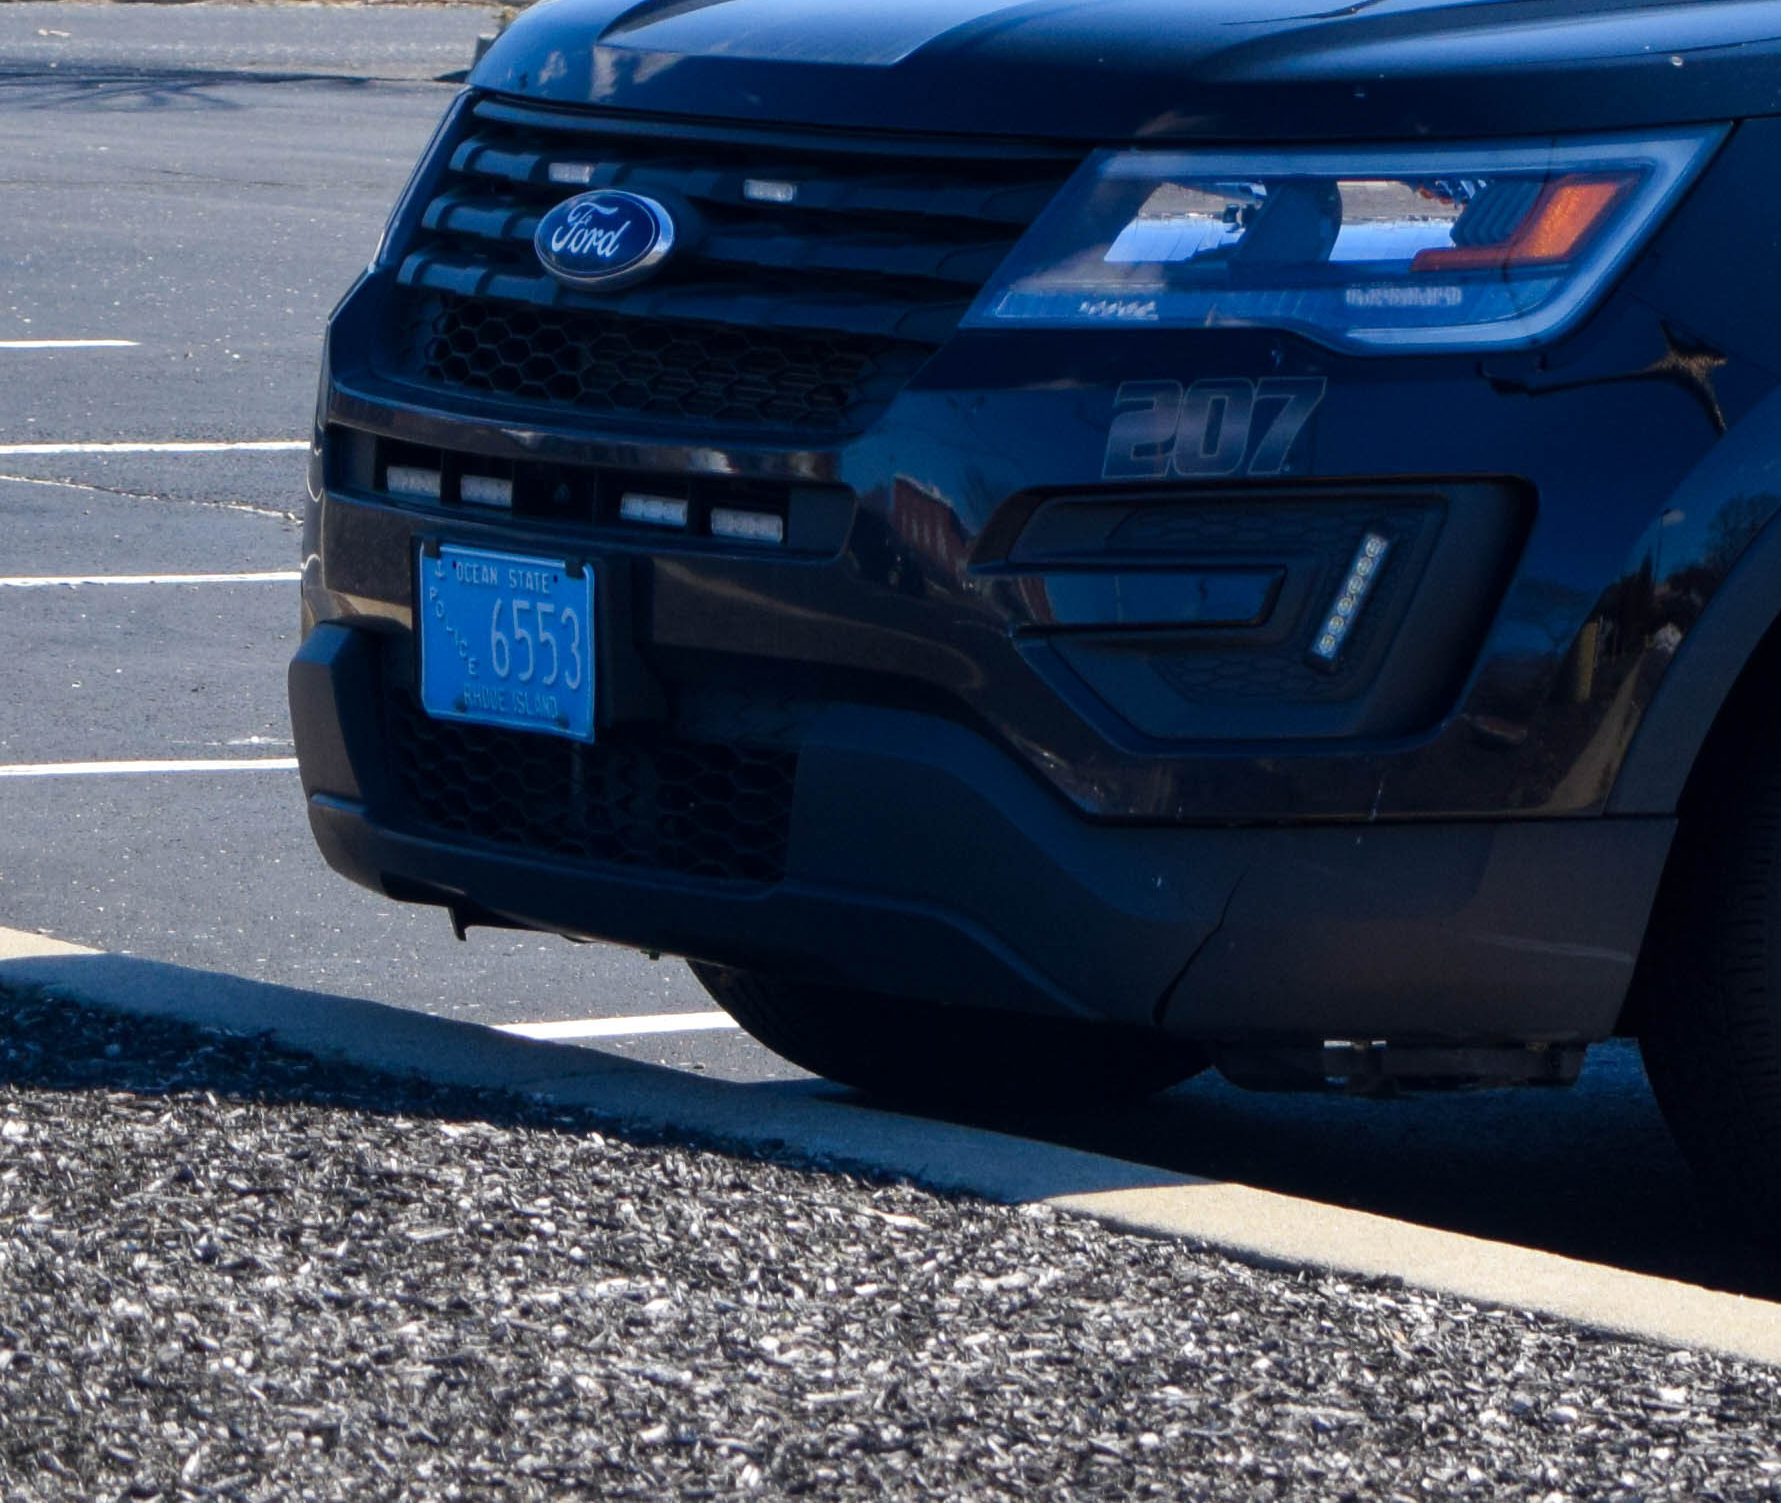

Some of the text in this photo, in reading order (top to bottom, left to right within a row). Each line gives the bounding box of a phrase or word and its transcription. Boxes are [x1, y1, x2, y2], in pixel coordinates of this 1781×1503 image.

[551, 201, 632, 258] Ford
[1102, 376, 1328, 480] 207
[456, 561, 551, 594] OCEAN STATE
[490, 597, 582, 691] 6553
[463, 683, 559, 719] RHODE ISLAND
